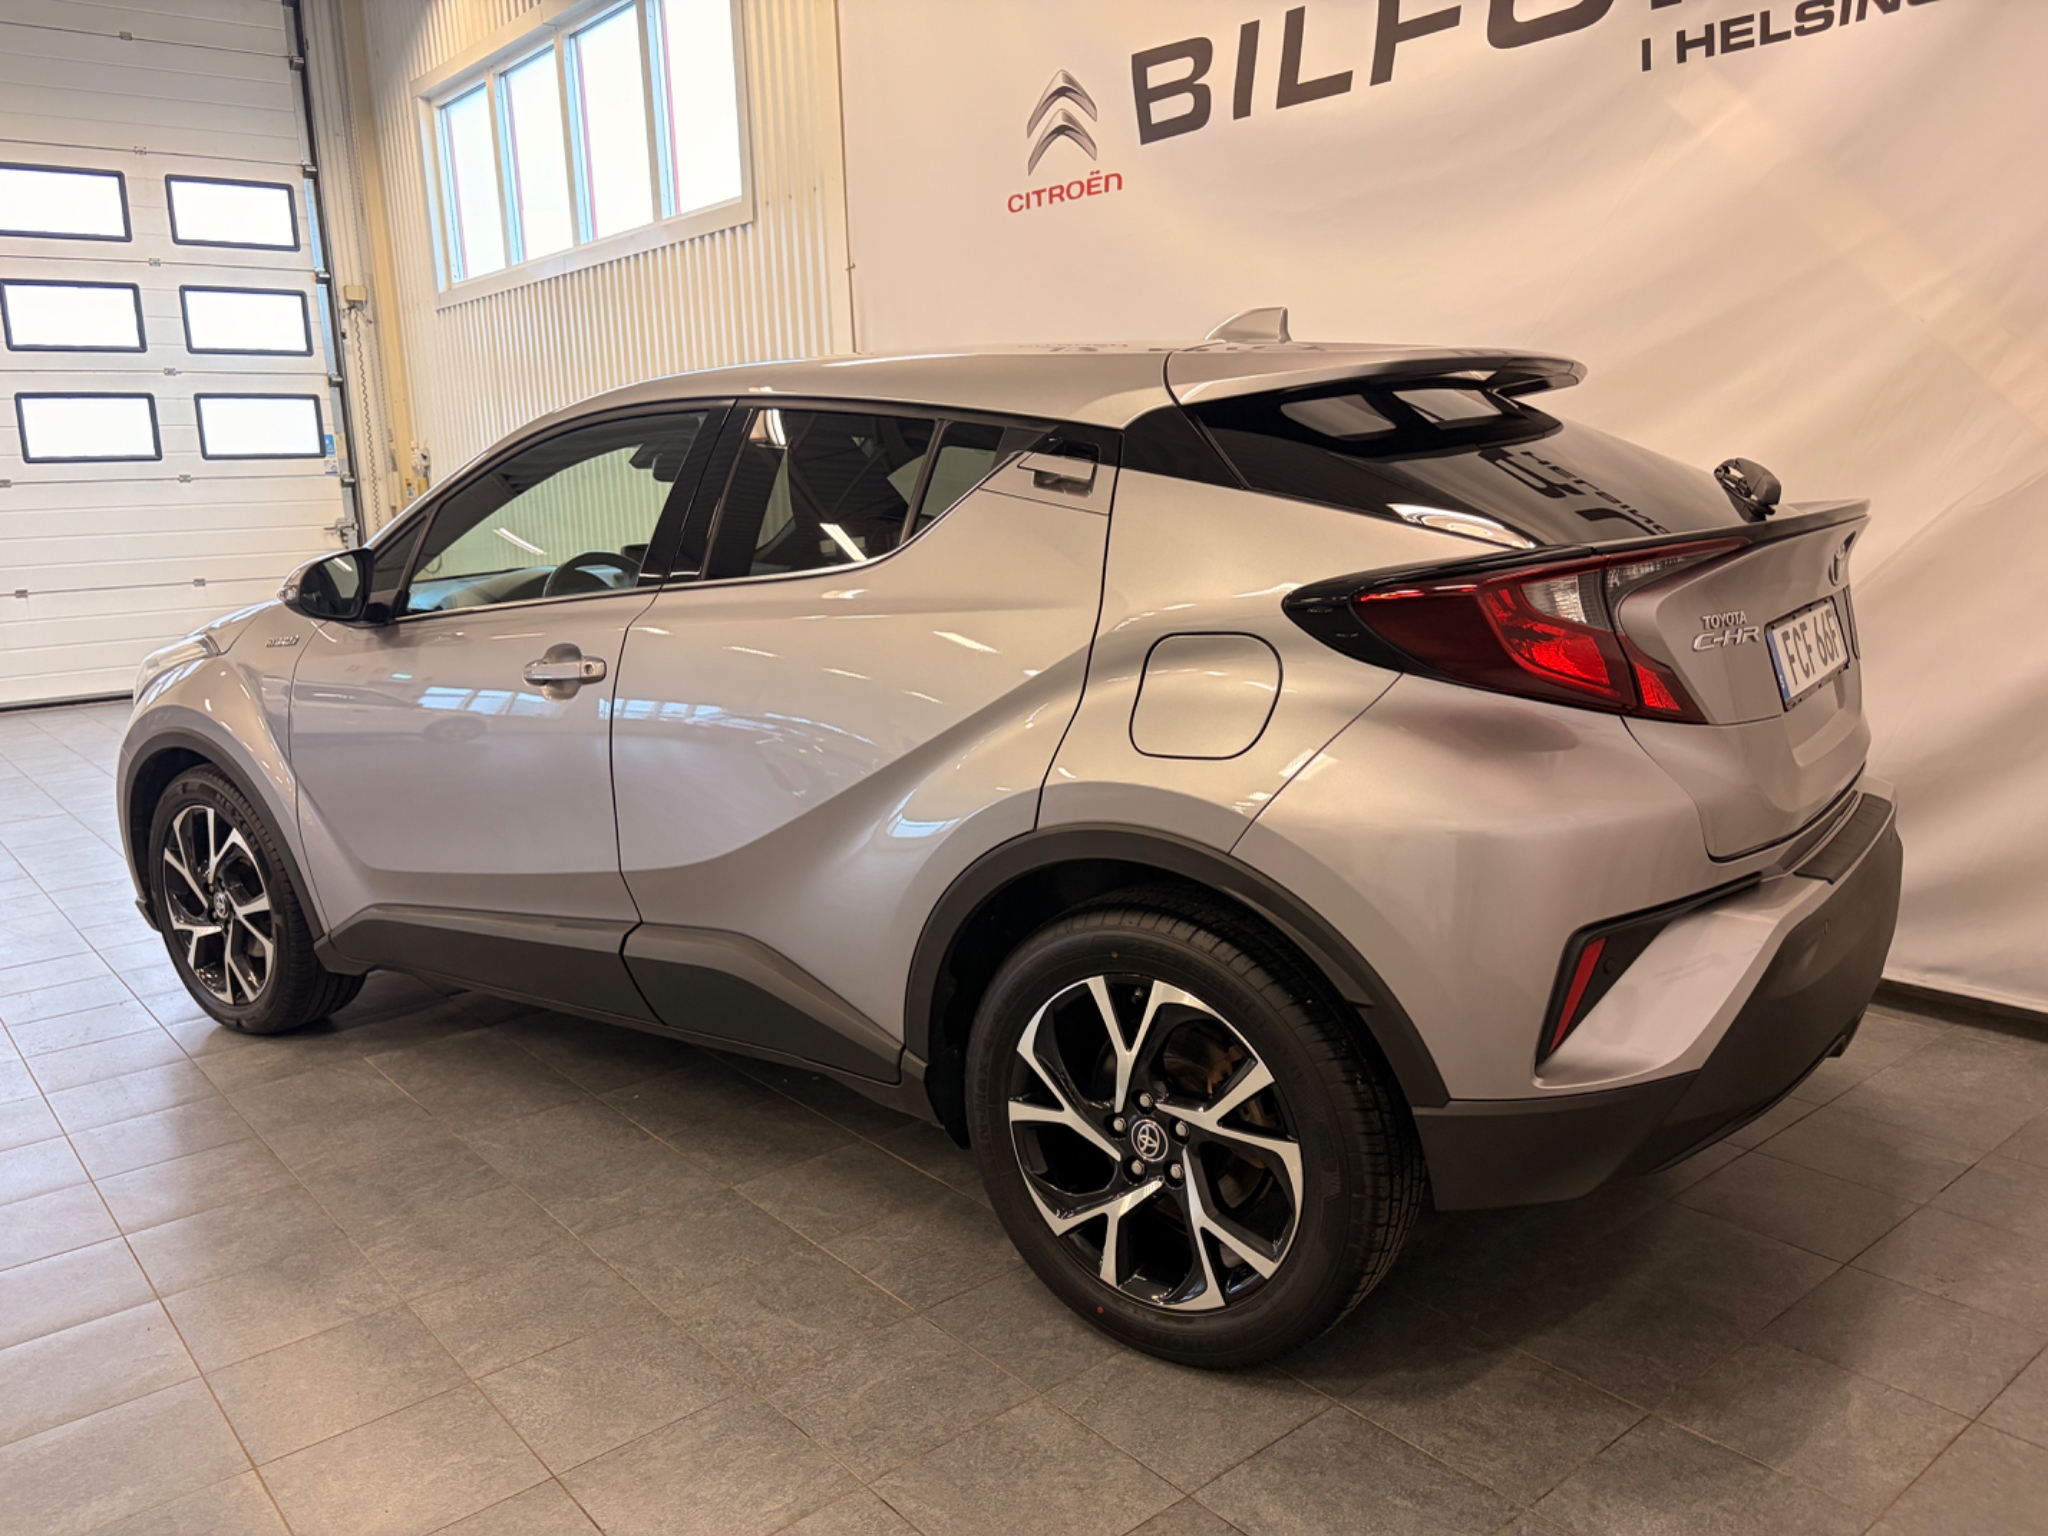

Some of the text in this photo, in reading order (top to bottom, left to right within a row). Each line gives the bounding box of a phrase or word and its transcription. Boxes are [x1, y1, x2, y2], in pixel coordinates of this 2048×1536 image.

[1641, 0, 1940, 72] I HELSIN
[1693, 626, 1760, 651] C-HR
[1701, 610, 1748, 630] TOYOTA
[1781, 621, 1816, 686] FCF
[214, 792, 259, 853] NEXEN
